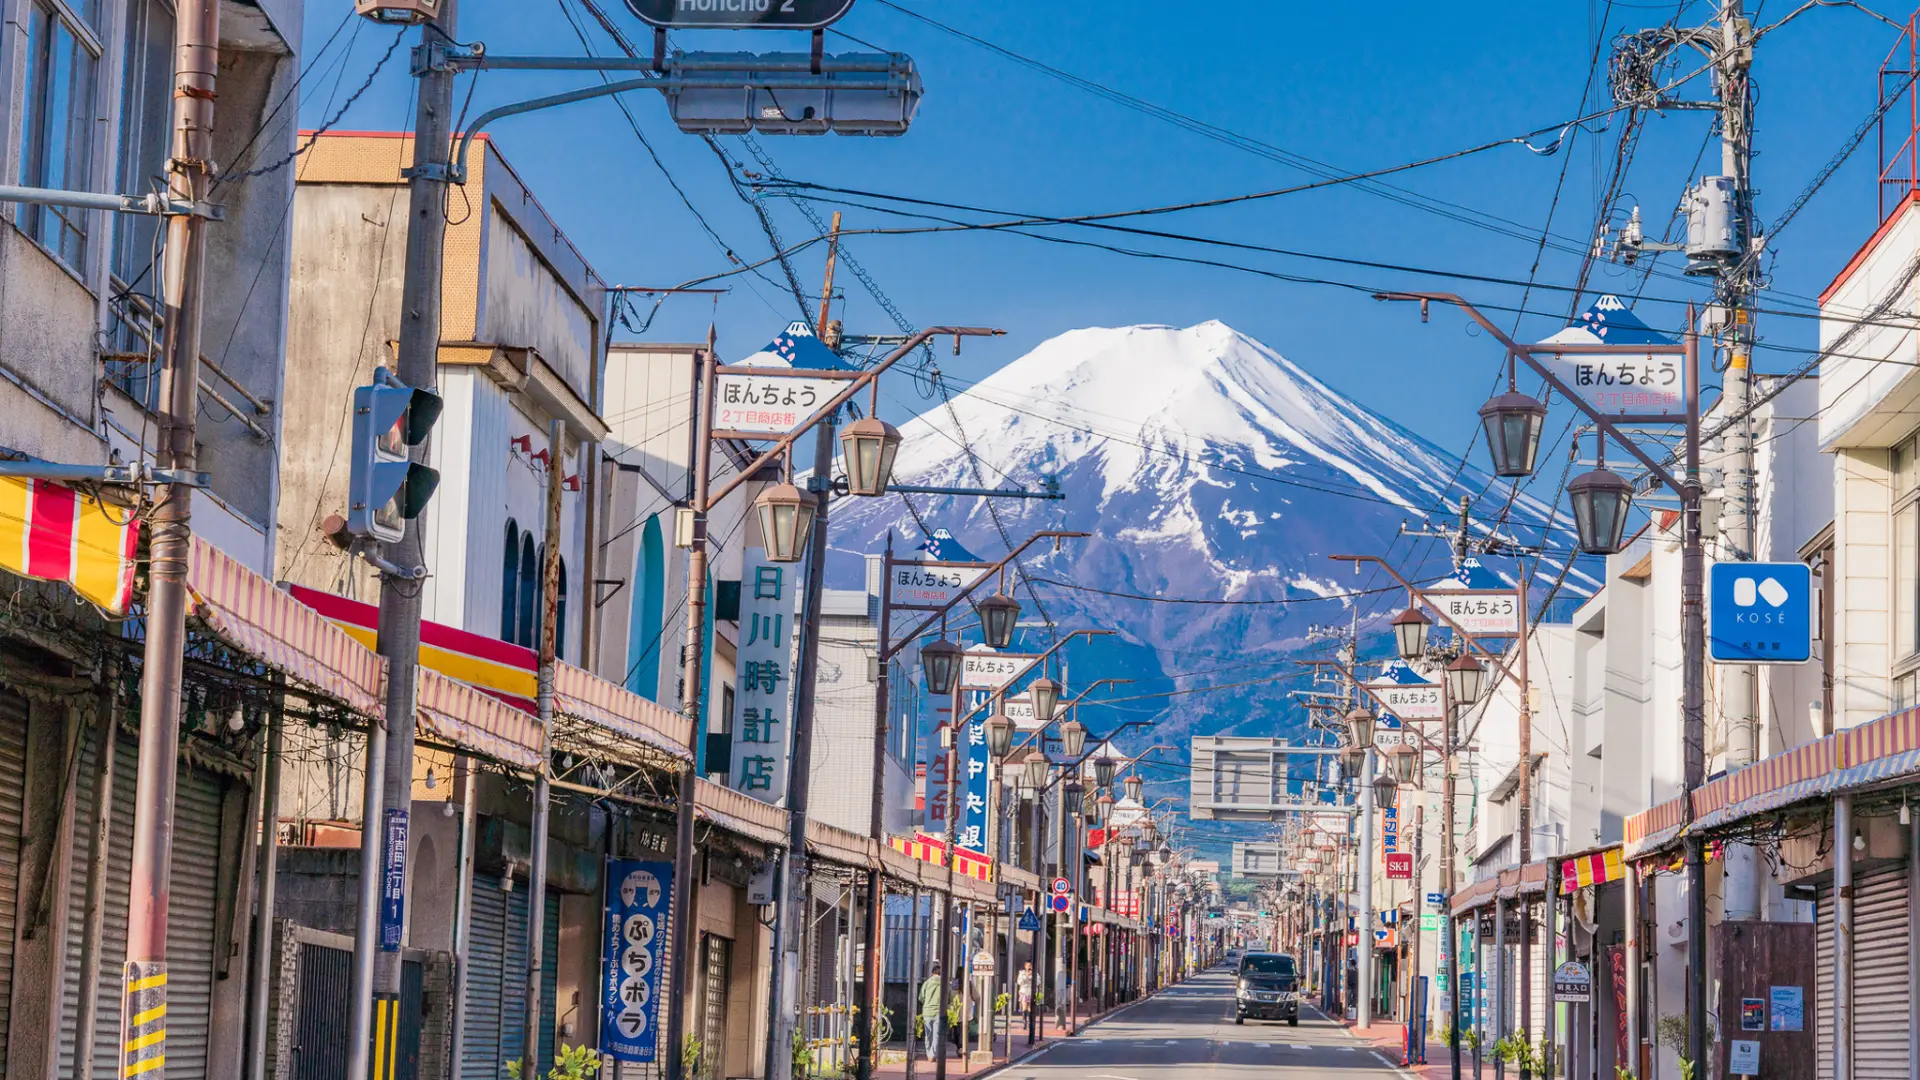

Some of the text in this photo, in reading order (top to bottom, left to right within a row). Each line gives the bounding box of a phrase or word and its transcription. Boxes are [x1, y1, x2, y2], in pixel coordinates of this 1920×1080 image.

[780, 0, 795, 12] 2
[1575, 362, 1676, 386] ほんちょう
[723, 382, 816, 407] ほんちょう
[1596, 391, 1676, 406] 2丁目商店街
[722, 409, 796, 426] 2丁目商店街
[898, 570, 962, 588] ほんちょう
[1450, 600, 1513, 615] ほんちょう
[1736, 610, 1785, 624] KOSÉ
[965, 660, 1016, 674] ほんちょう
[738, 565, 784, 791] 日川時計店
[1389, 691, 1438, 704] ほんちょう
[1007, 707, 1032, 717] ほんち
[1376, 734, 1416, 745] ほんちう
[958, 689, 985, 848] 山梨中央銀
[392, 827, 406, 900] 下吉田二丁目
[1056, 881, 1066, 890] 40
[621, 920, 649, 1034] ぷちボラ
[1556, 983, 1588, 992] 明見入口
